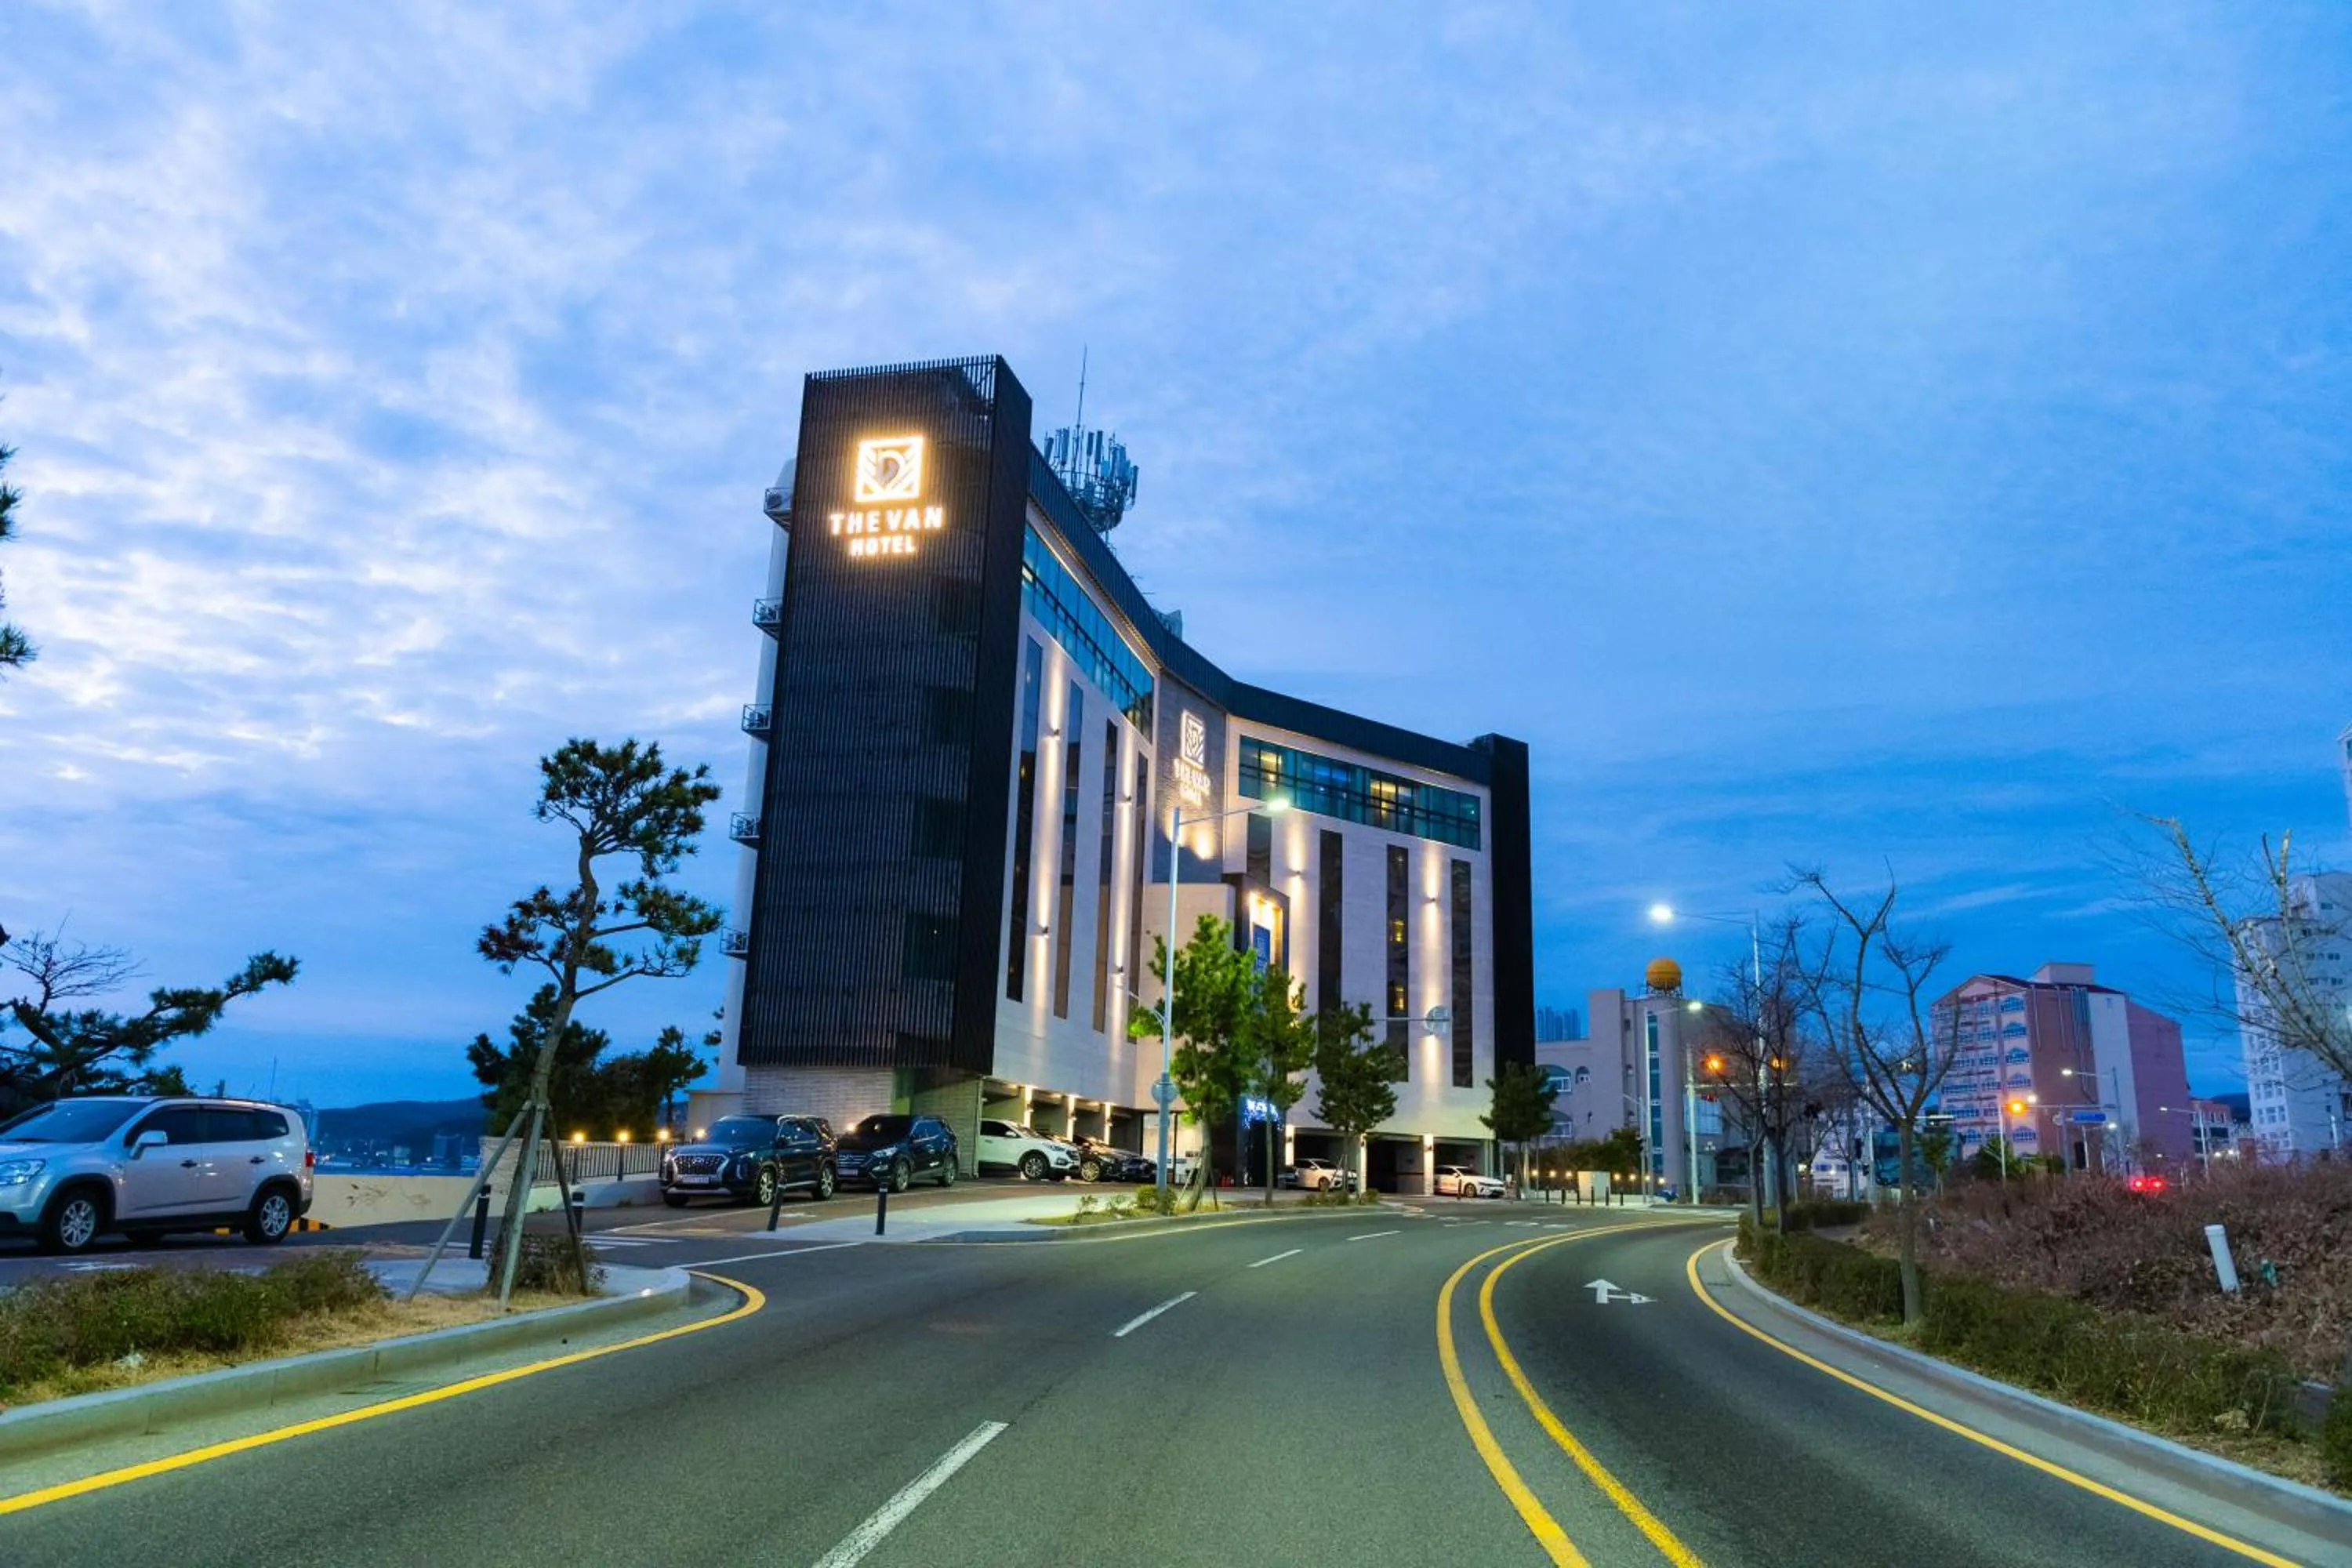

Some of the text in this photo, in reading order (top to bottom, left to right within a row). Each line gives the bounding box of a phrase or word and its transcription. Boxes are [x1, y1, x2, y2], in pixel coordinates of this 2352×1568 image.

[829, 506, 943, 535] THE VAN
[851, 536, 916, 556] HOTEL
